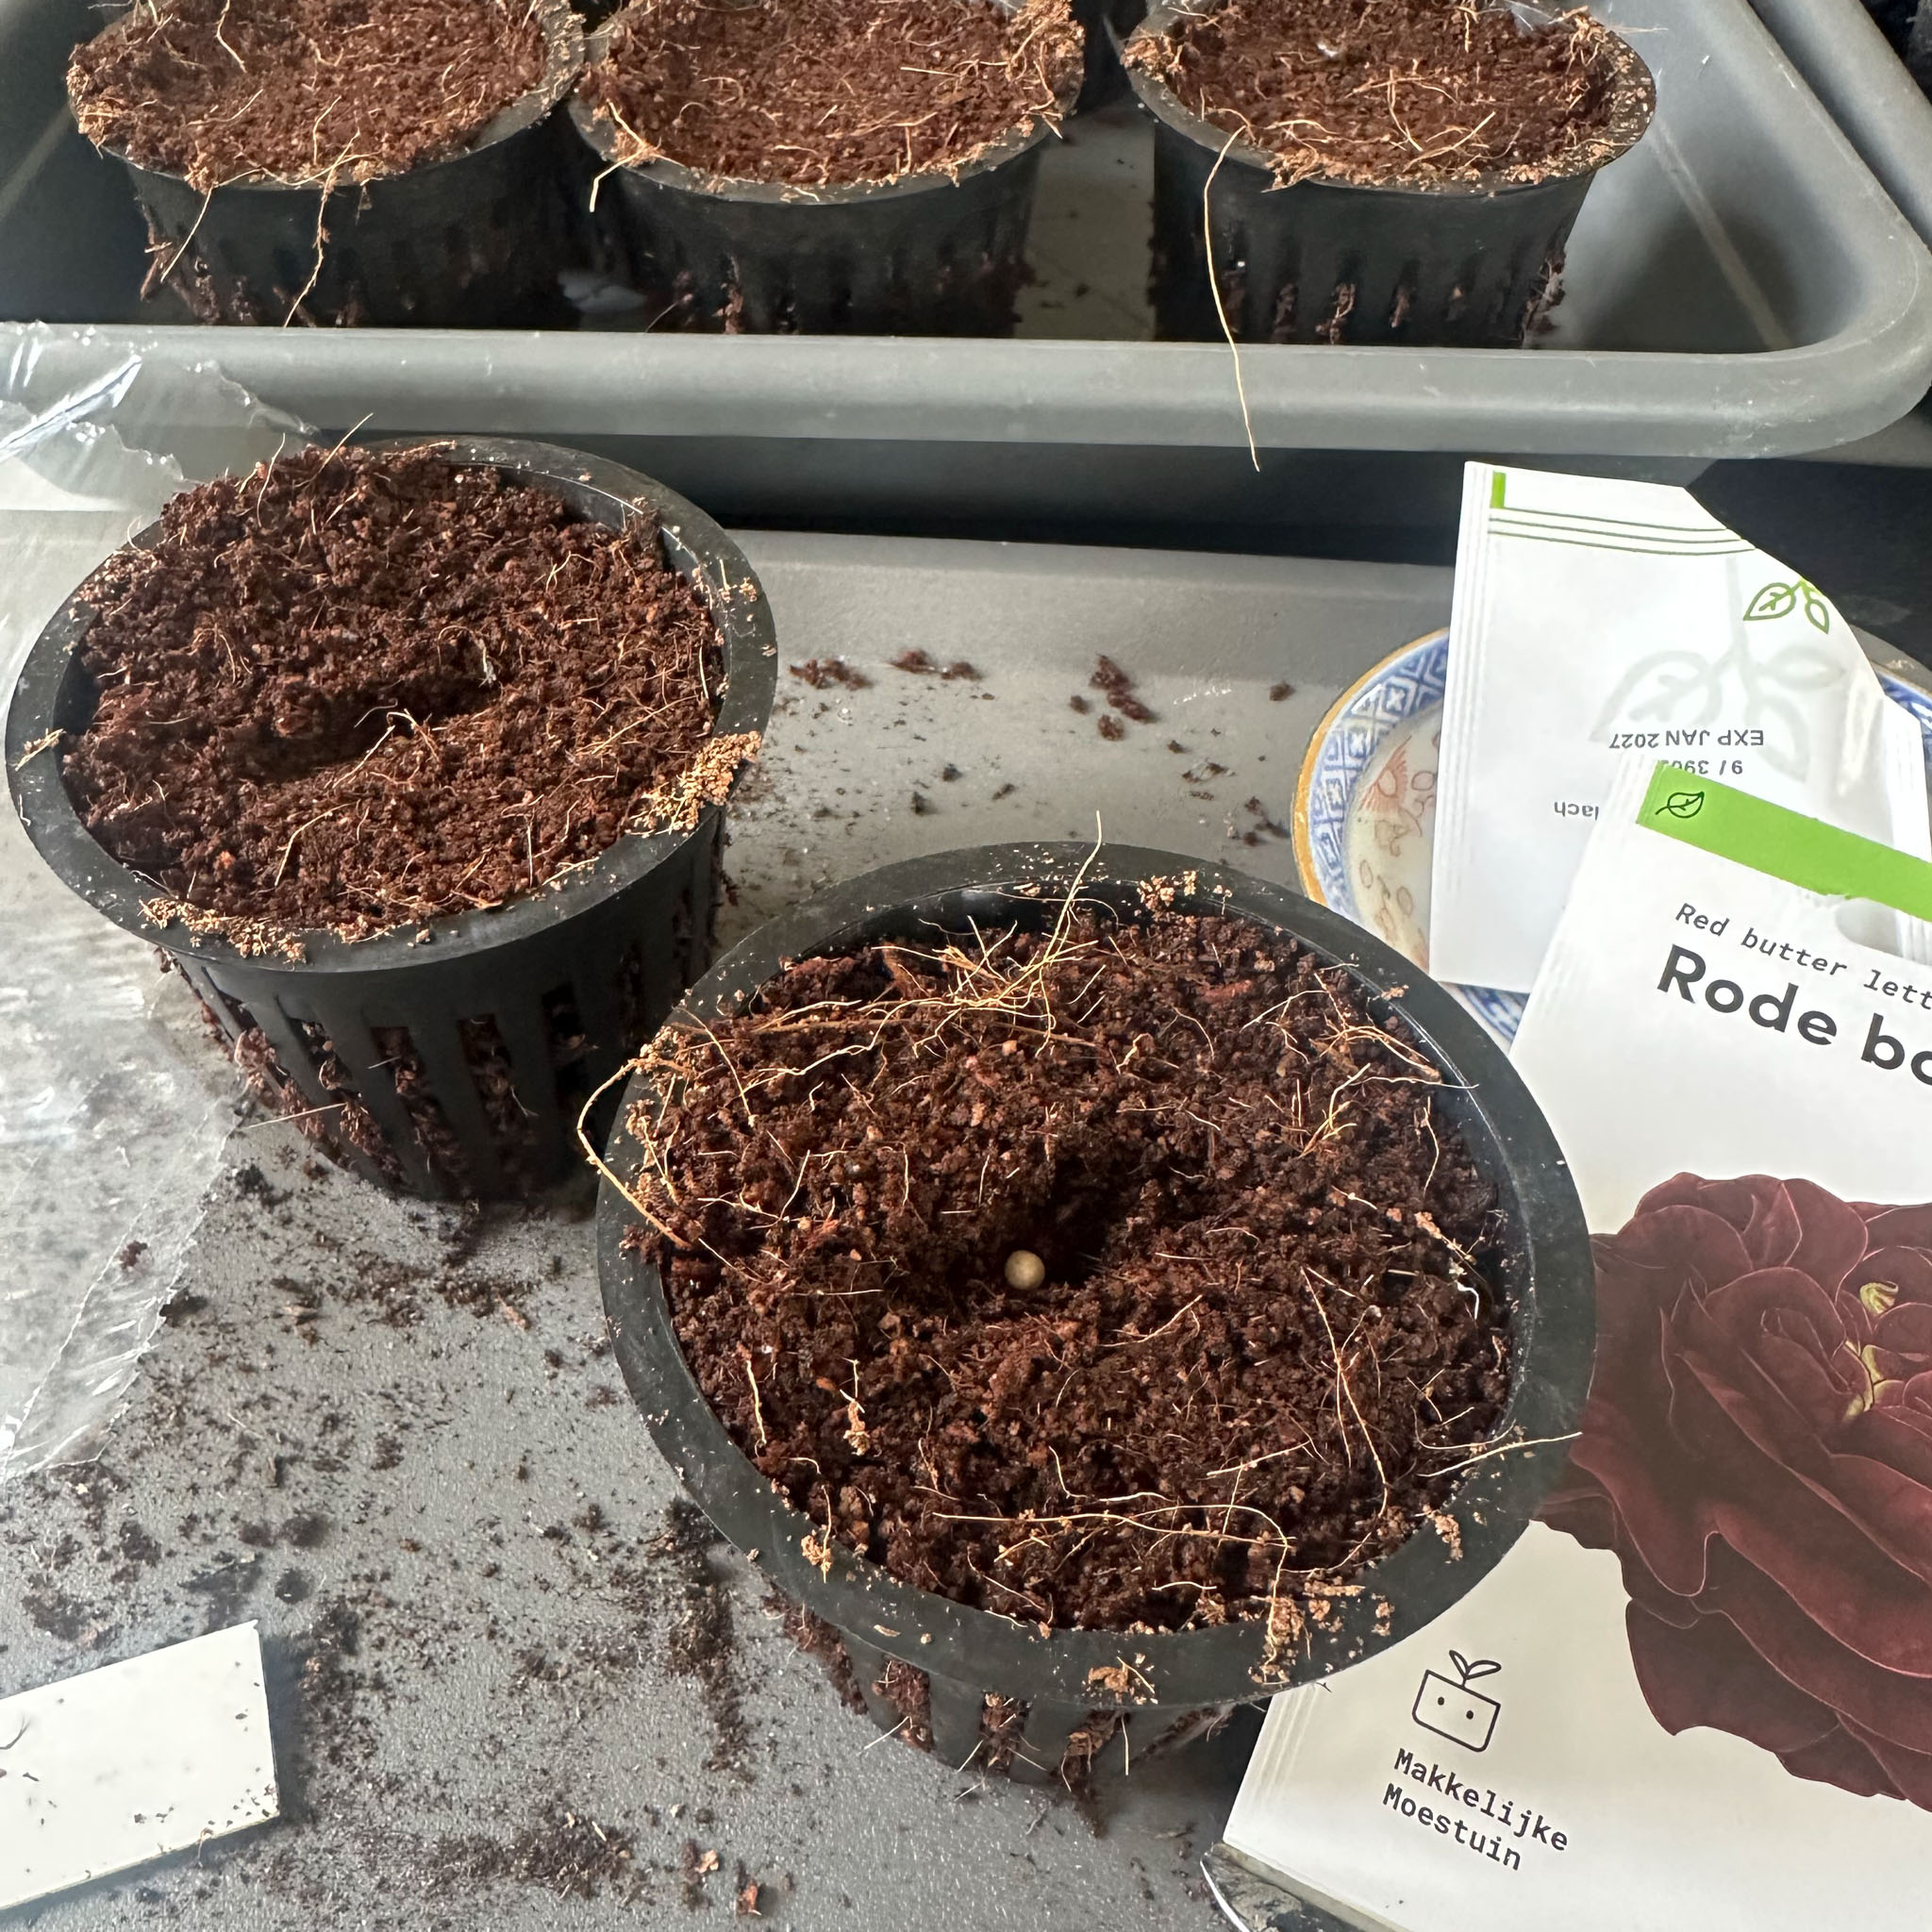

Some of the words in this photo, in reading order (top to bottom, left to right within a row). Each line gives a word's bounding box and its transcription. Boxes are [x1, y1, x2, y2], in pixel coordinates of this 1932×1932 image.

[1608, 733, 1659, 749] 2027
[1665, 729, 1710, 746] JAN
[1718, 729, 1764, 746] EXP
[1657, 759, 1709, 774] 390
[1675, 903, 1730, 937] Red
[1740, 927, 1847, 975] butter
[1863, 969, 1932, 1010] lett
[1657, 943, 1837, 1045] Rode
[1393, 1747, 1568, 1851] Makkelijke
[1382, 1782, 1521, 1871] Moestuin
